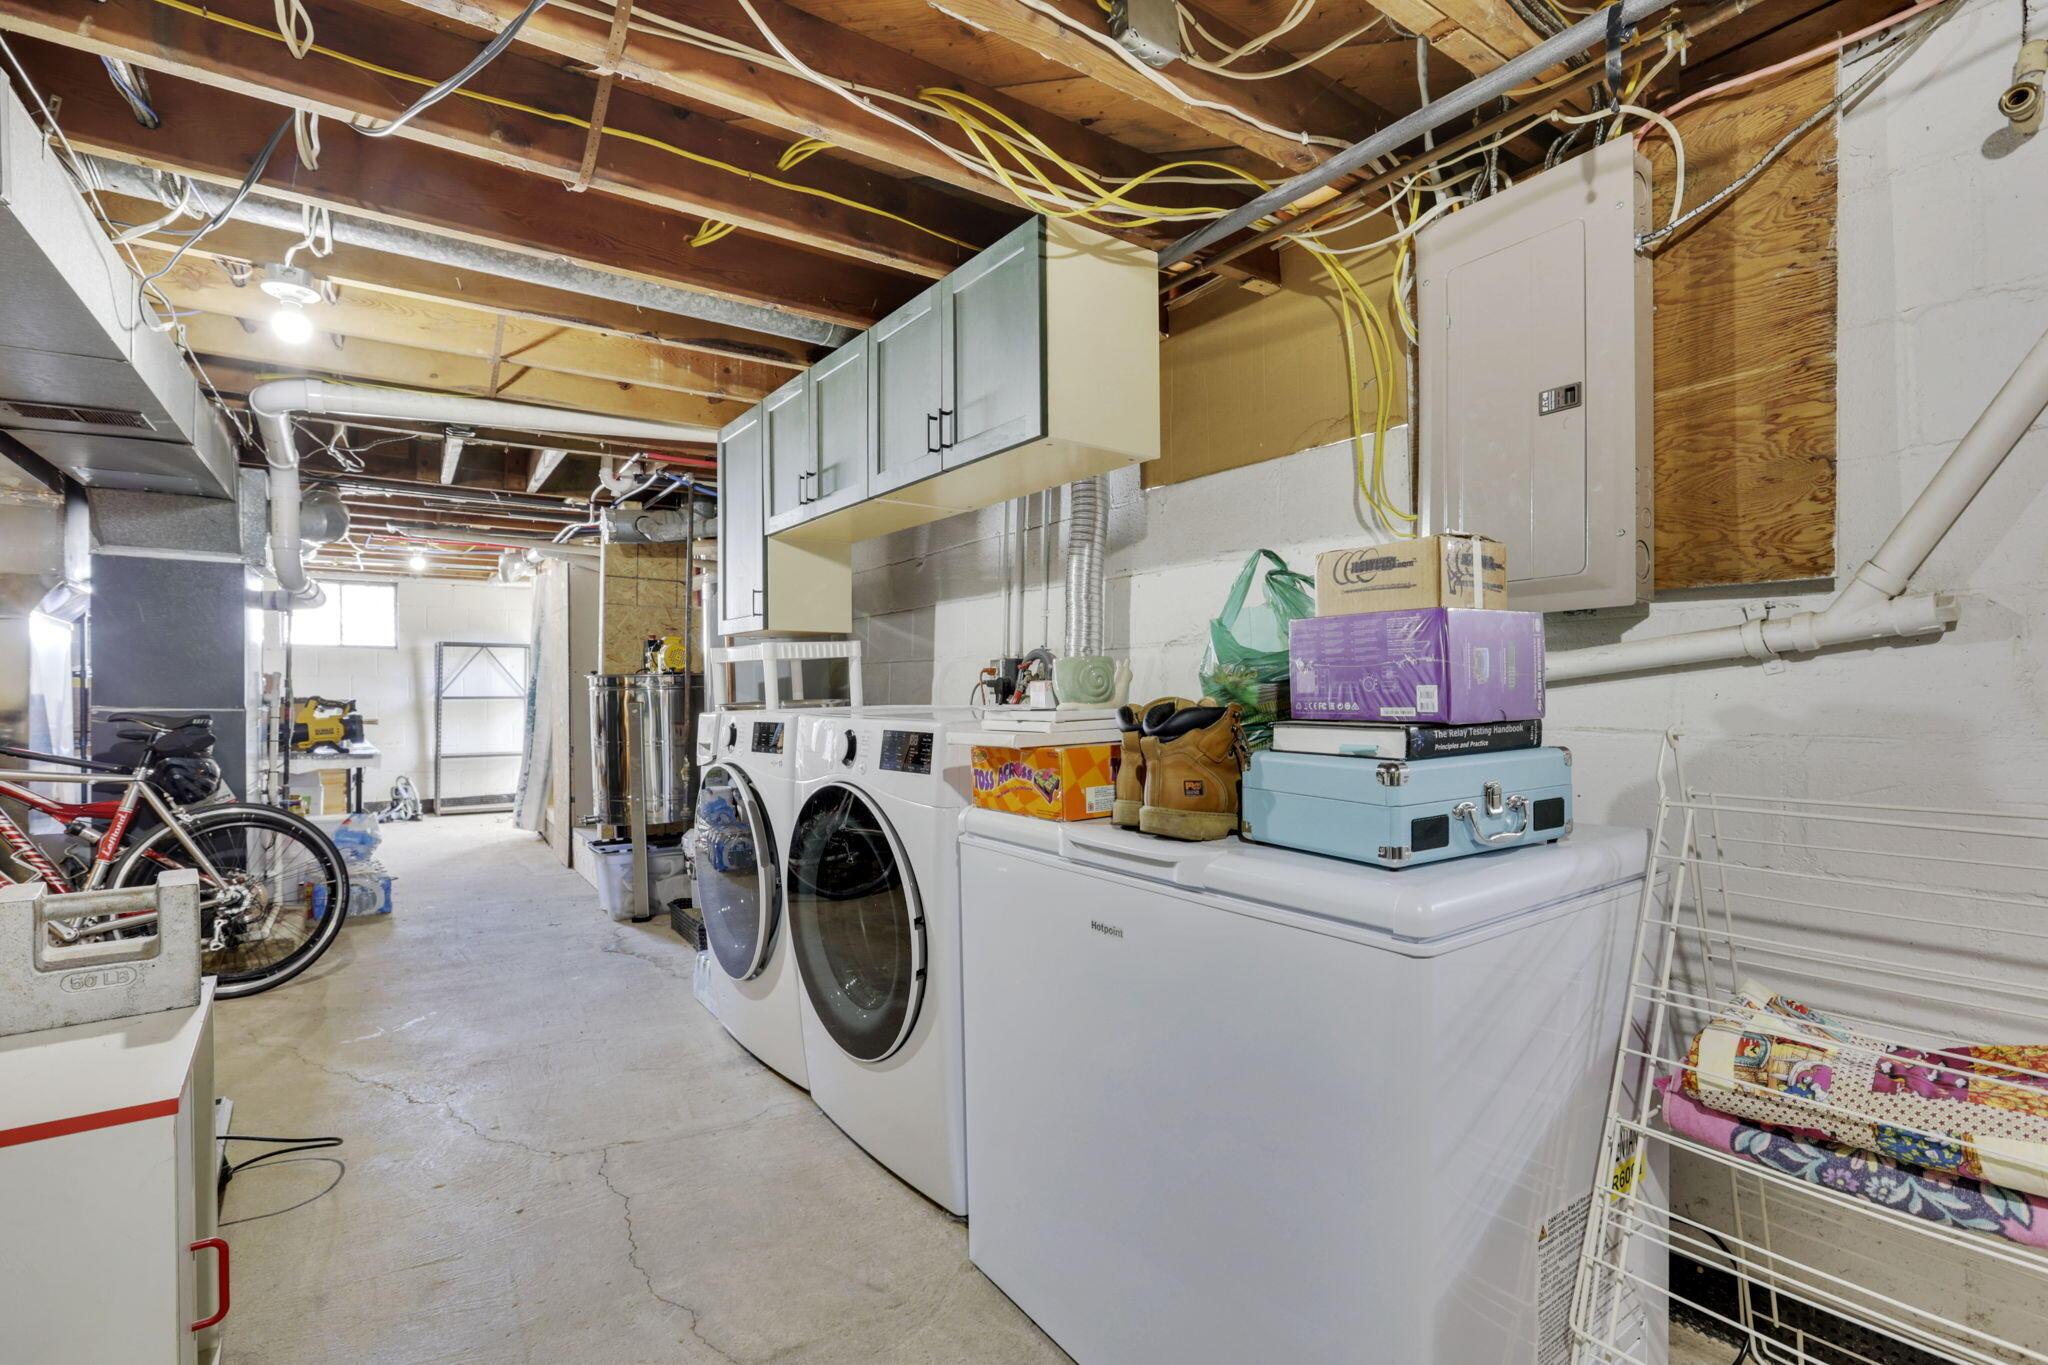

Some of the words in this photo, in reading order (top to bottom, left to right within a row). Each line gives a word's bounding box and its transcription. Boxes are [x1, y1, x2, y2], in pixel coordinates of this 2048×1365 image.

[1434, 729, 1448, 739] The
[1449, 728, 1468, 738] Relay
[1469, 726, 1492, 737] Testing
[1493, 723, 1524, 734] Handbook
[1434, 742, 1459, 751] Principles
[1469, 740, 1489, 748] Practice
[974, 768, 995, 790] TOSS
[998, 761, 1033, 787] ACROSS
[1091, 920, 1124, 939] Hotpoint
[103, 969, 130, 985] LB
